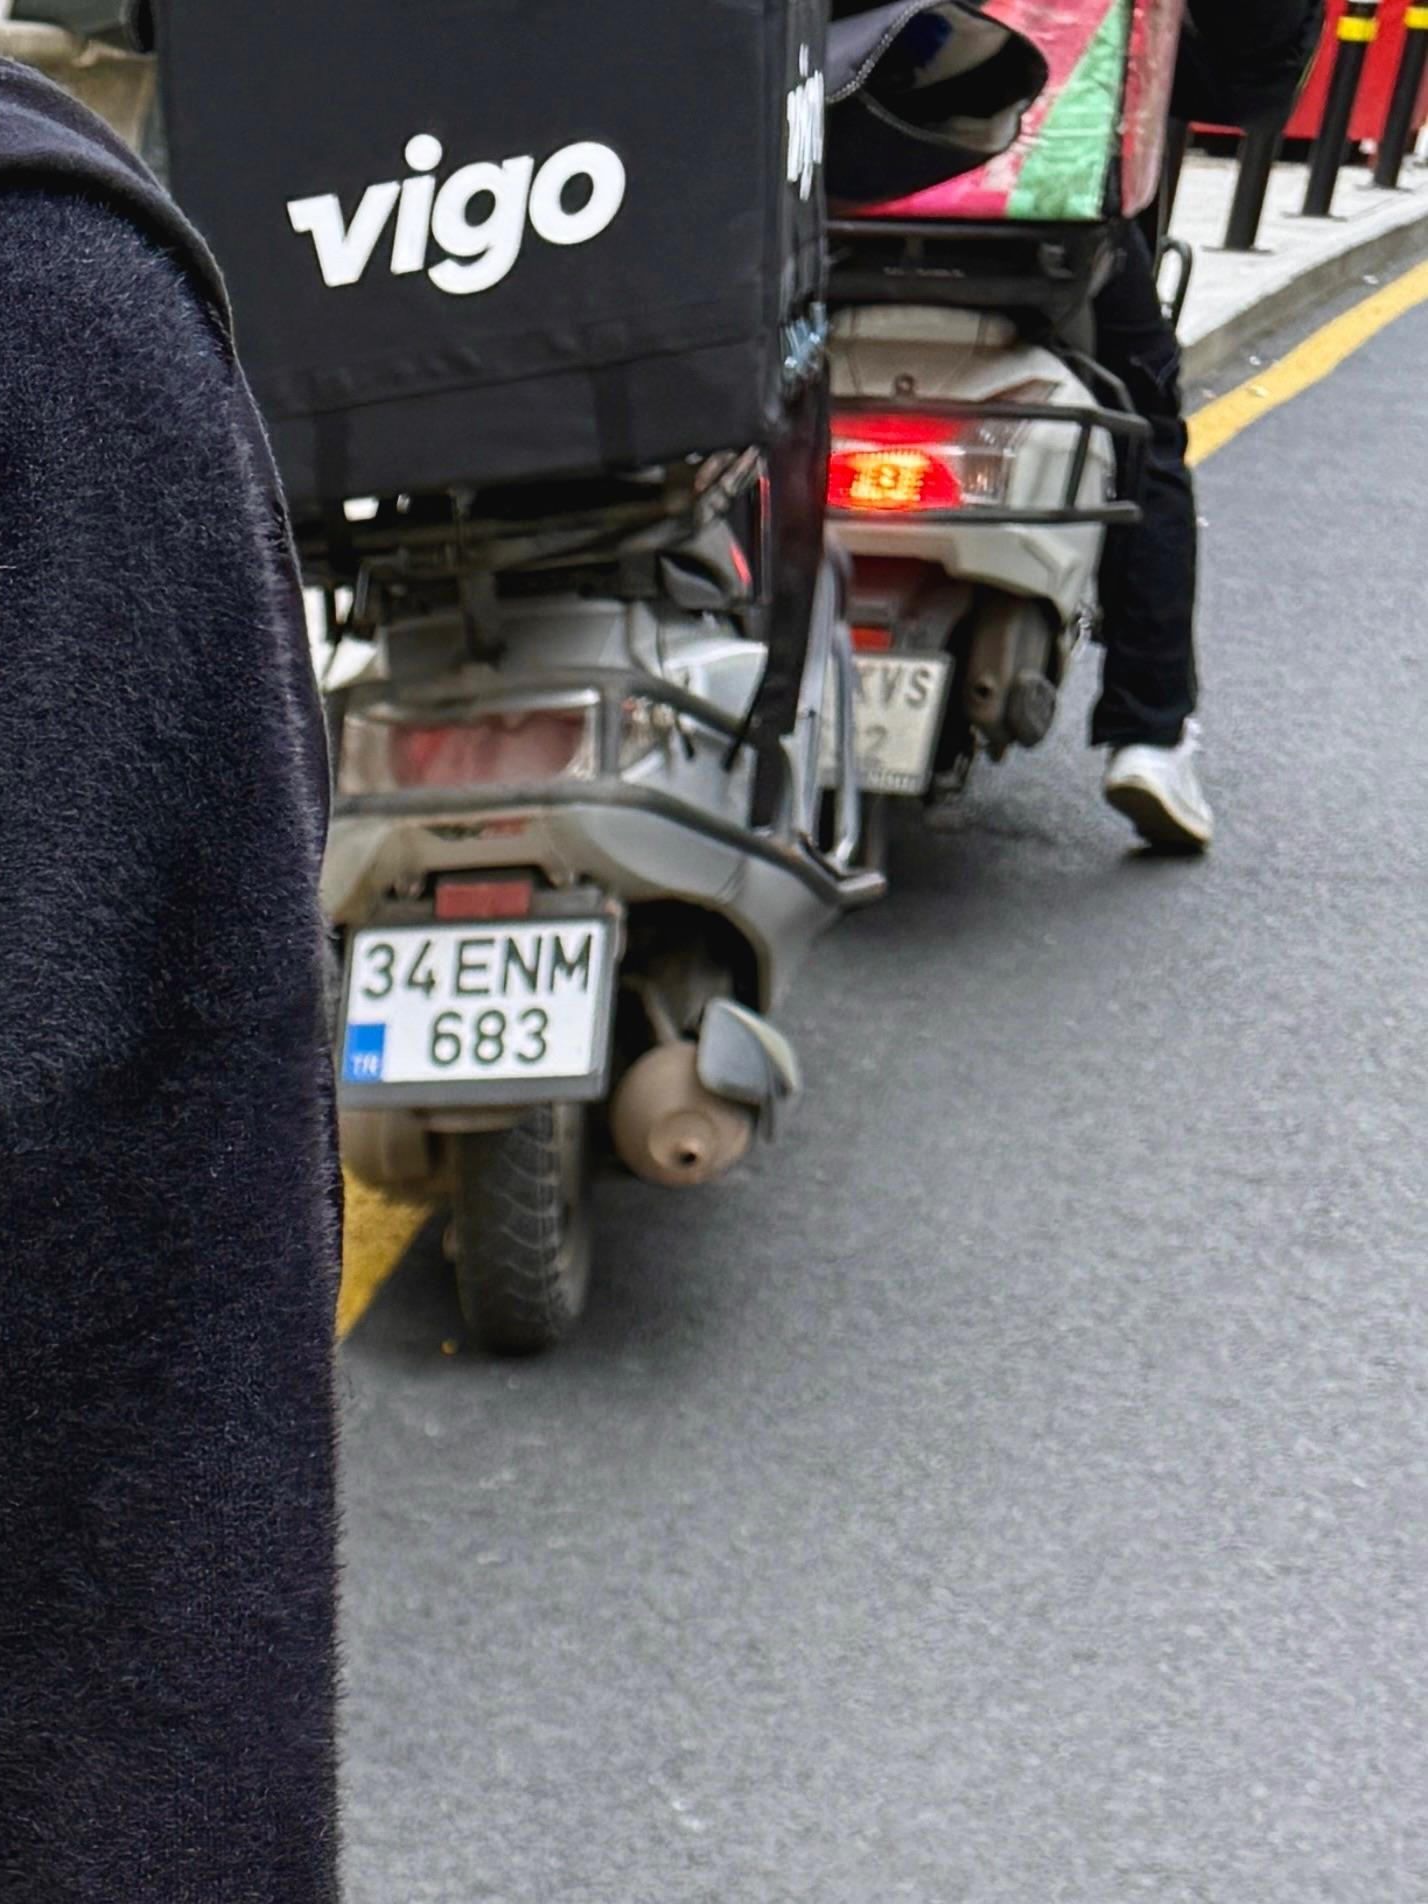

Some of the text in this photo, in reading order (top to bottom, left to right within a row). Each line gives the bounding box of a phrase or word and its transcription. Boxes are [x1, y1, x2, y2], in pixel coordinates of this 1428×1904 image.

[287, 133, 626, 294] vigo
[362, 933, 593, 1000] 34 ENM
[430, 1007, 549, 1067] 683
